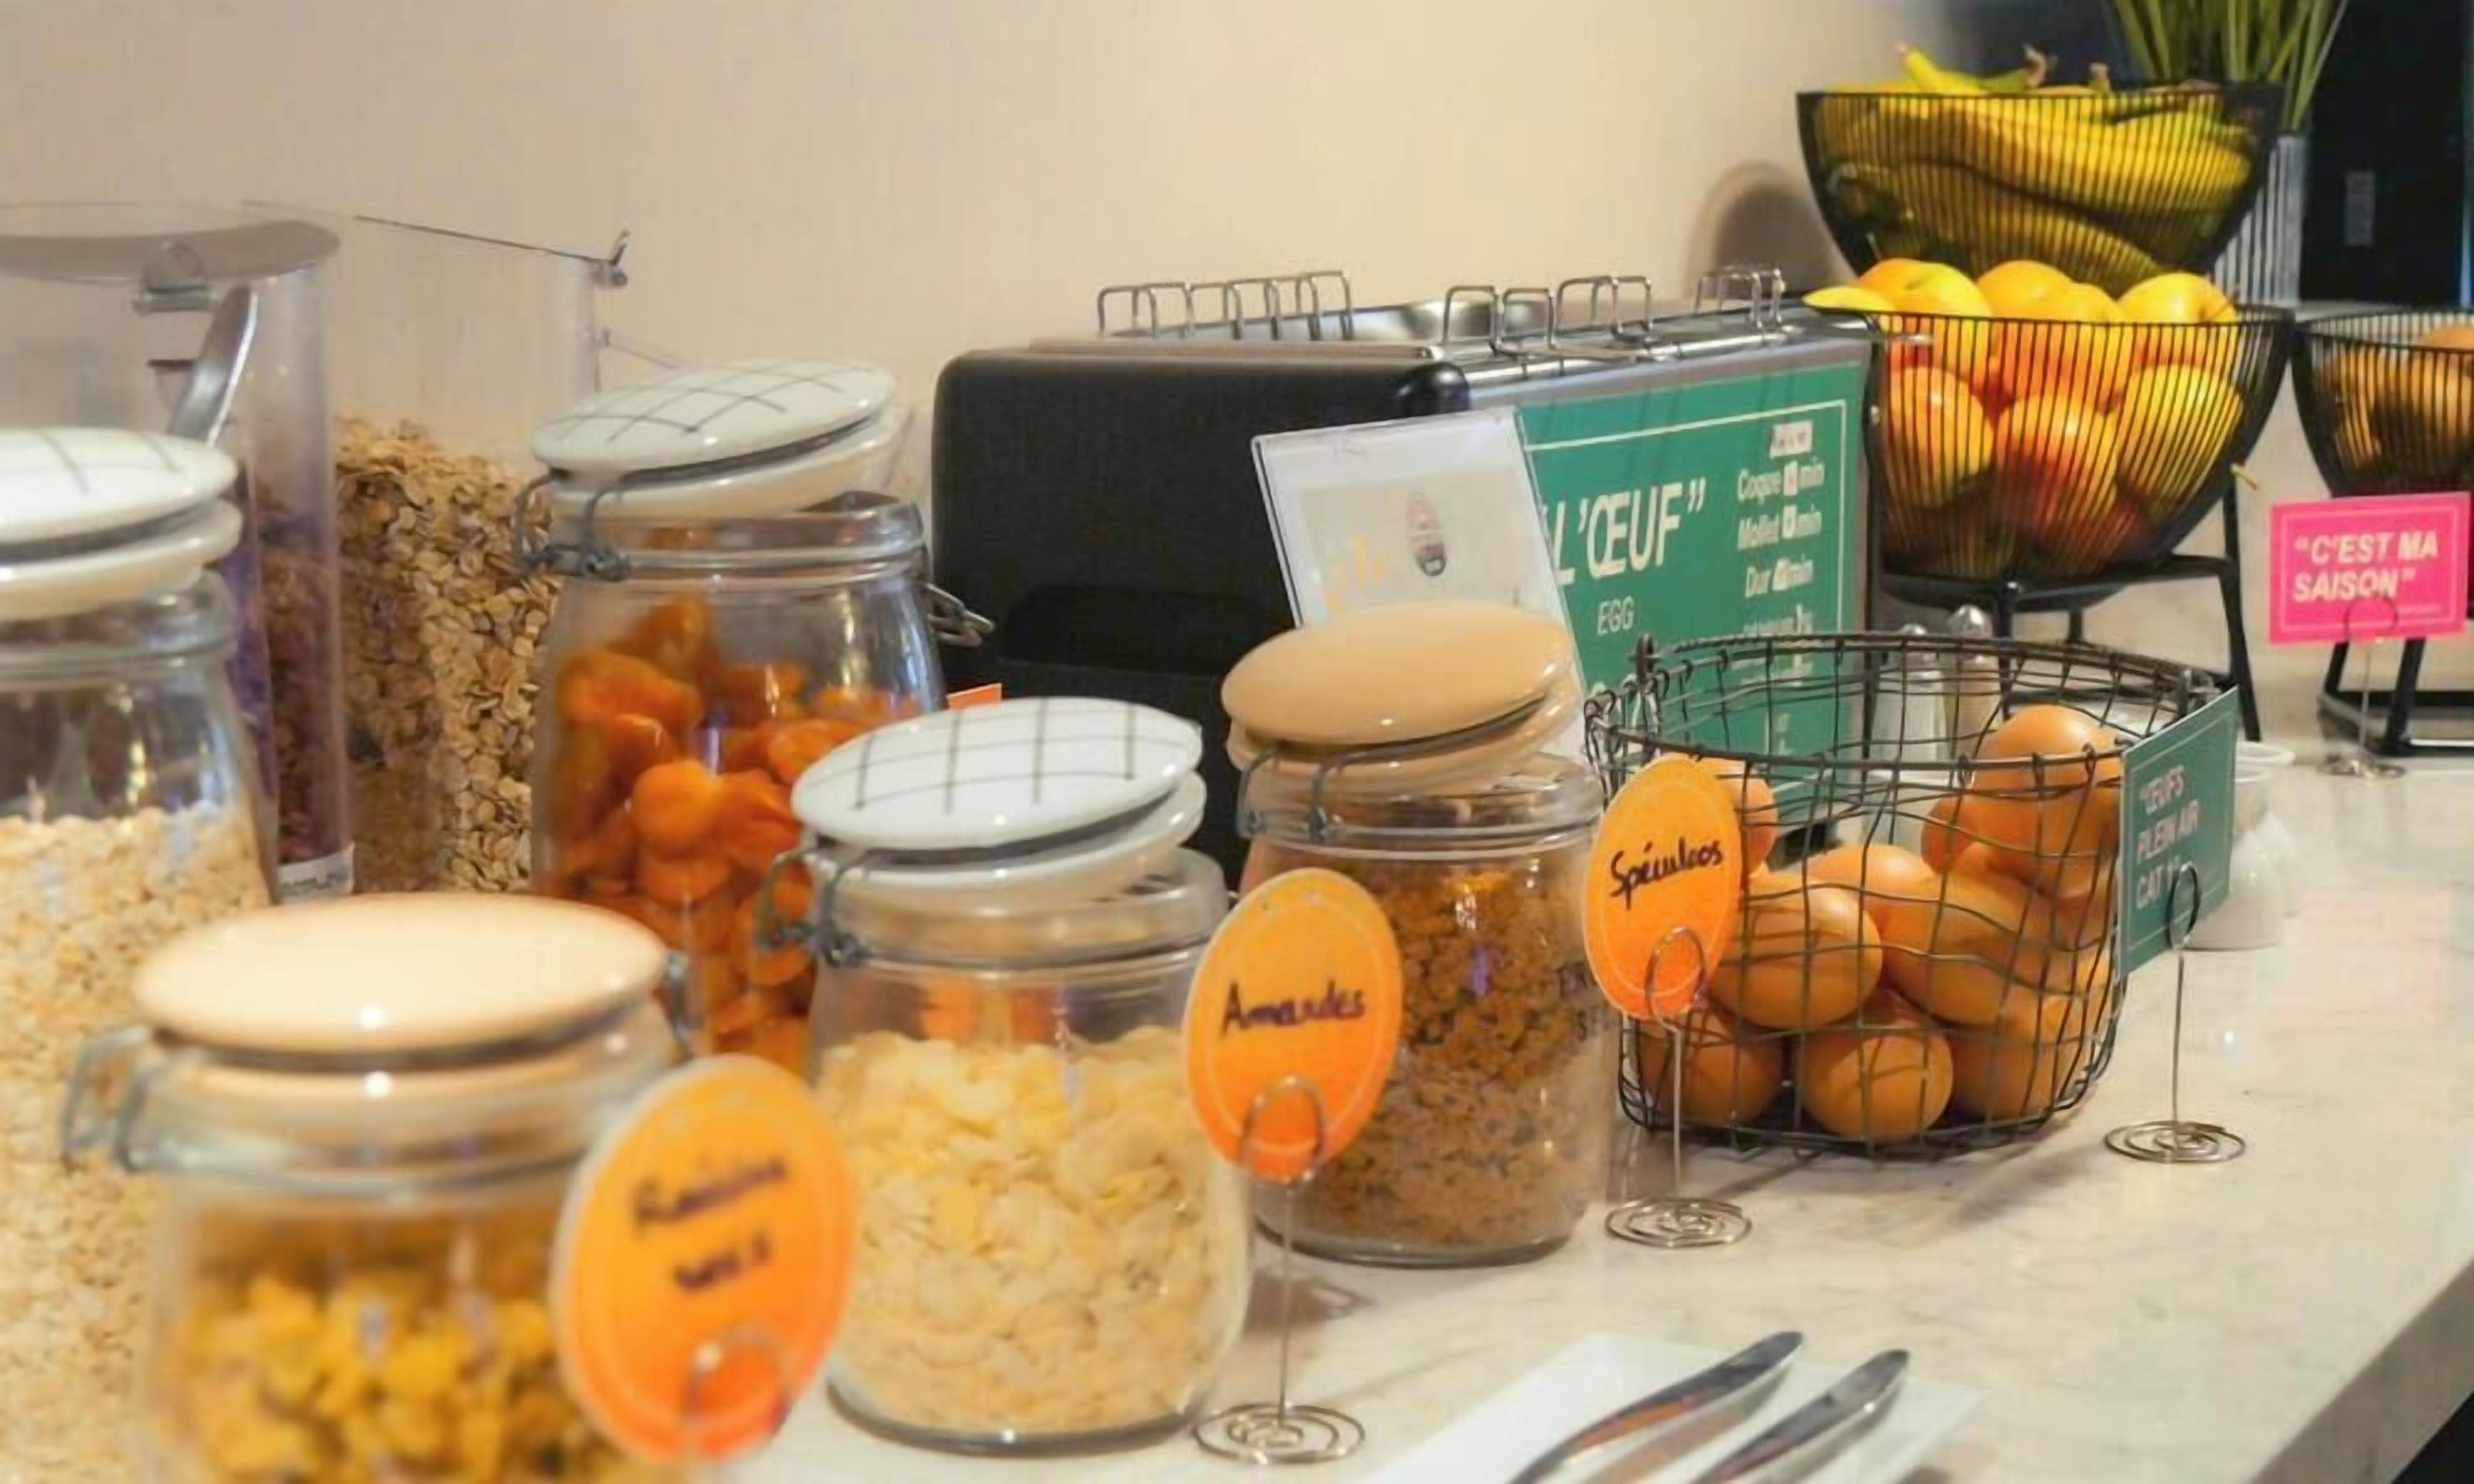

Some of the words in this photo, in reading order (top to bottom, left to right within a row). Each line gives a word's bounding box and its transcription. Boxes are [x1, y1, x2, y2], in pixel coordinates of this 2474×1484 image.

[2294, 531, 2394, 565] "C'EST
[2397, 529, 2439, 560] MA
[2294, 567, 2415, 602] SAISON"
[1598, 595, 1634, 636] EGG
[1609, 837, 1723, 911] Spéculoos
[1219, 978, 1366, 1040] Amandes
